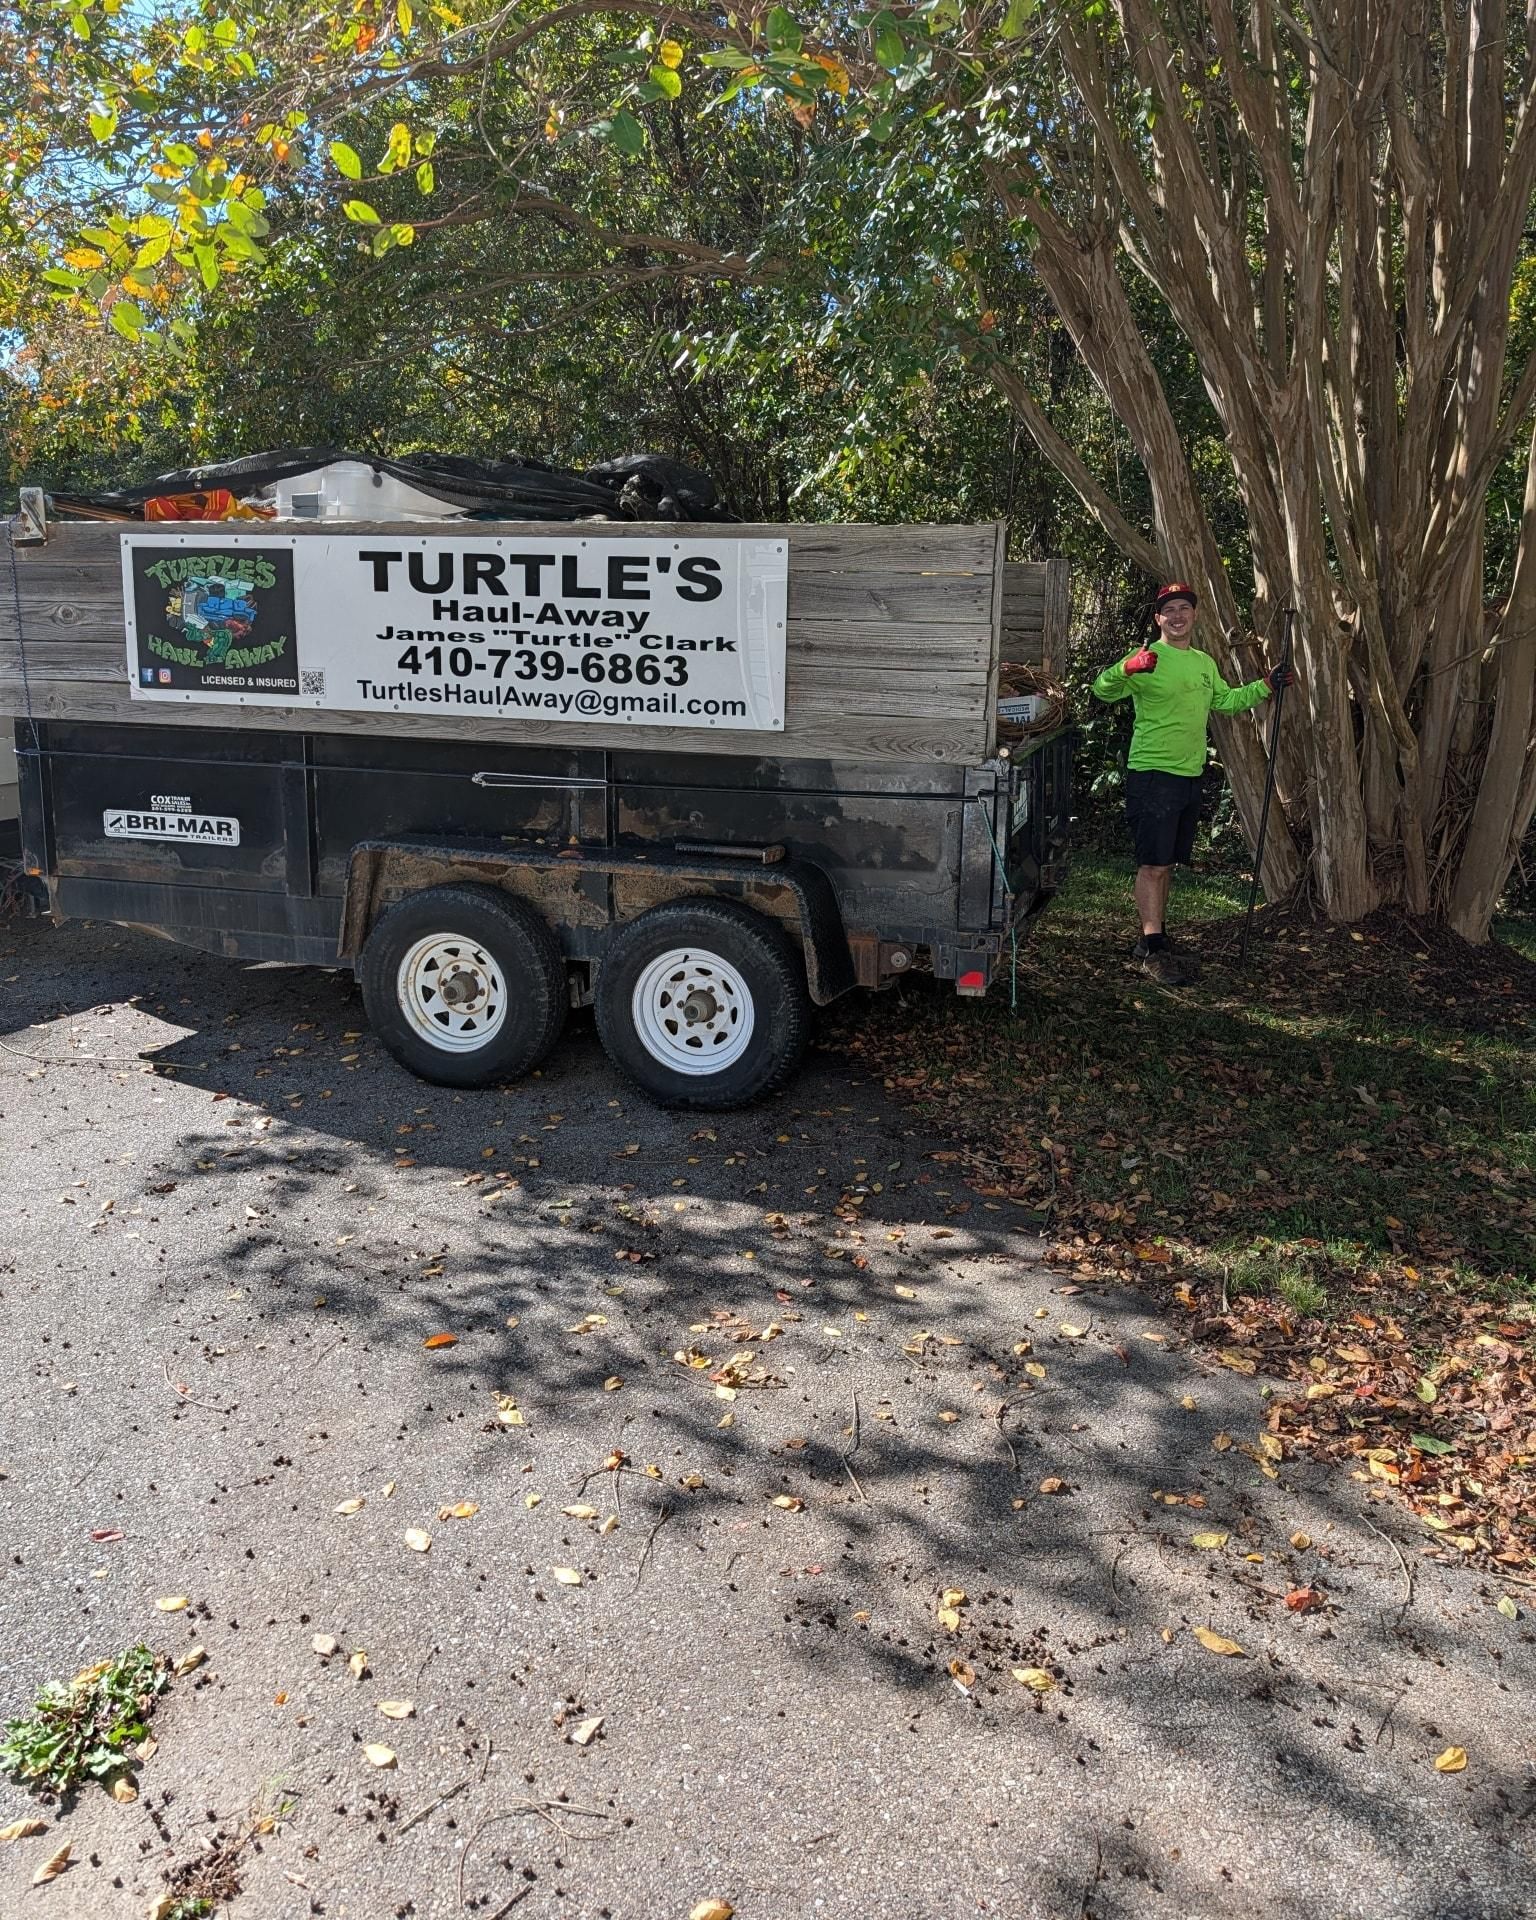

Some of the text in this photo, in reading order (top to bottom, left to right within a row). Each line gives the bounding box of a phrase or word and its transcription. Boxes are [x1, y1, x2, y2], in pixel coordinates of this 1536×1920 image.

[144, 555, 276, 588] TURTLE'S
[359, 551, 722, 601] TURTLE'S
[432, 600, 650, 633] Haul-Away
[148, 634, 287, 670] HAUL AWAY
[376, 625, 737, 652] James "Turtle" Clark
[201, 675, 296, 688] LICENSED & INSURED
[397, 645, 689, 686] 410-739-6863
[357, 680, 747, 717] TurtlesHaulAway@gmail.com
[151, 795, 171, 804] COX
[126, 814, 233, 836] BRI-MAR
[190, 834, 234, 842] TRAILERS
